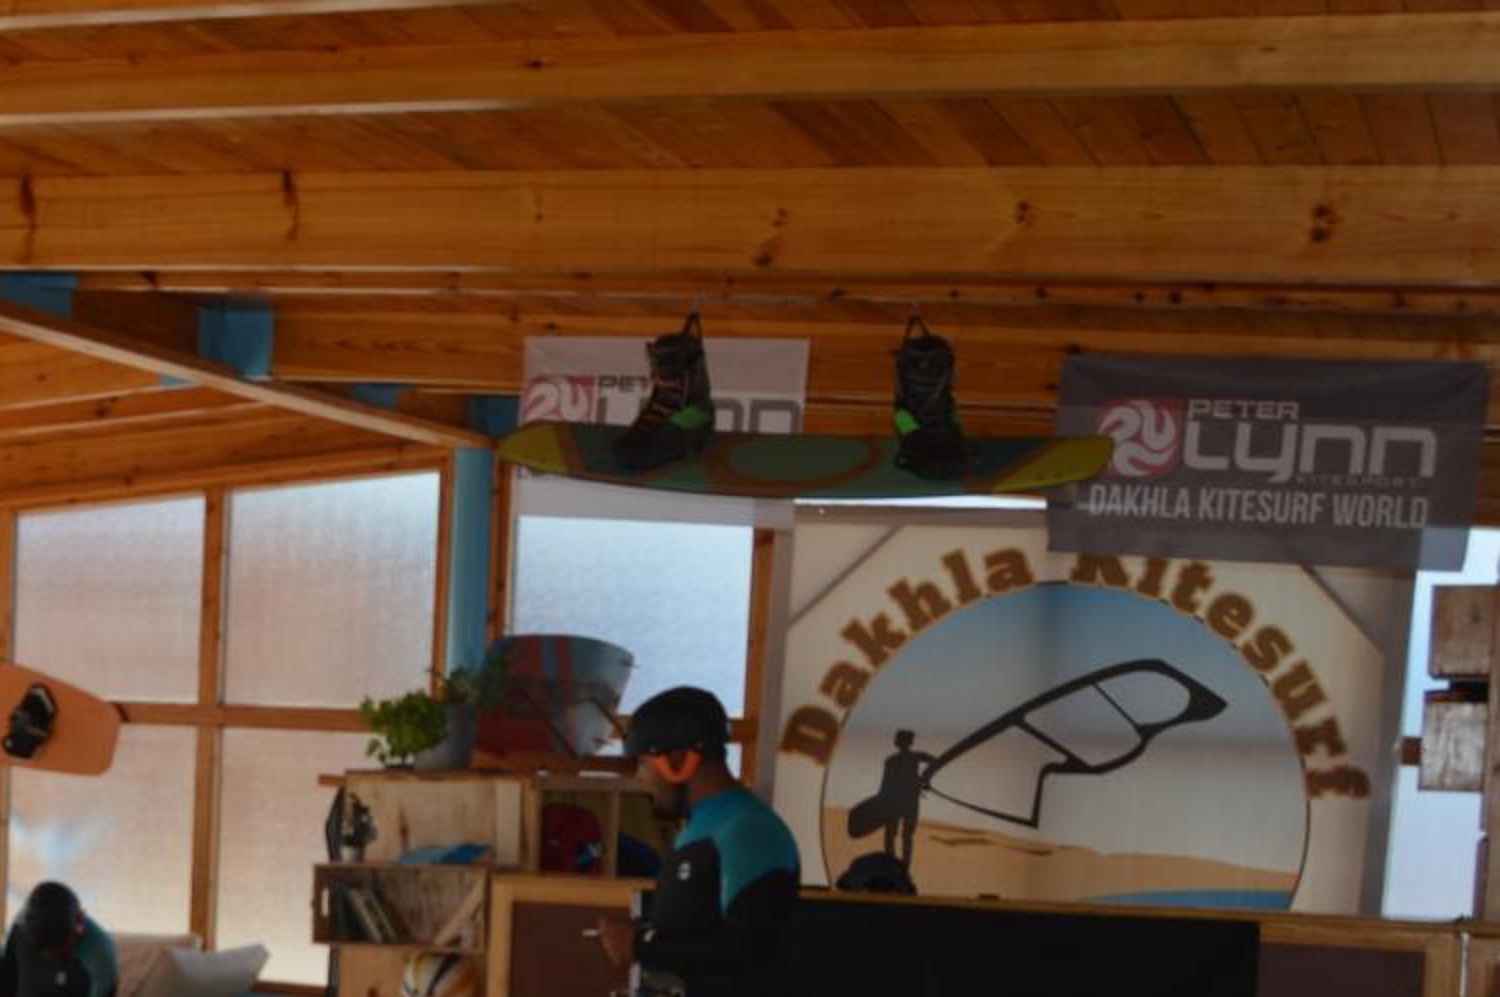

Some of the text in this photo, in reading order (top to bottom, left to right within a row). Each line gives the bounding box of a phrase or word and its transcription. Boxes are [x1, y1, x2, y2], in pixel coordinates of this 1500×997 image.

[599, 375, 648, 393] PET
[1187, 399, 1299, 421] PETER
[1184, 420, 1438, 484] Lynn
[1088, 484, 1429, 529] DAKHLA KITESURF WORLD
[780, 546, 1370, 799] Dakhla Kitesurf
